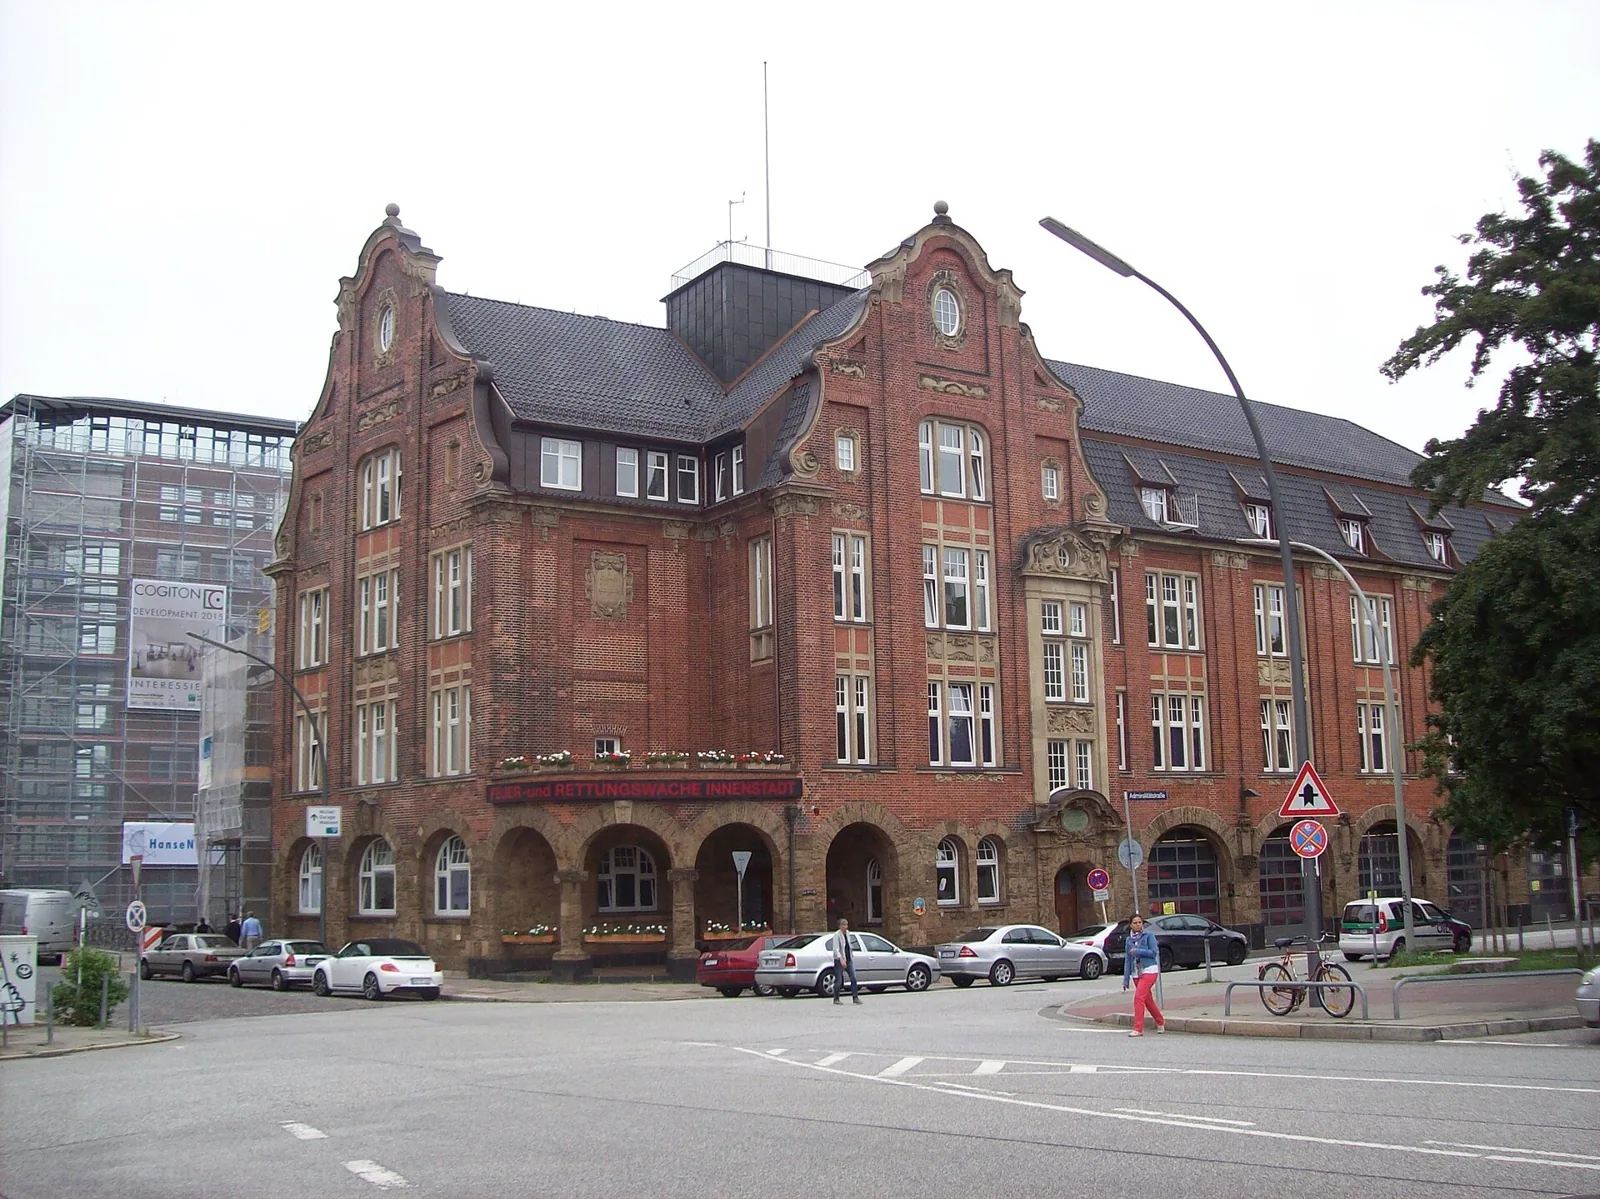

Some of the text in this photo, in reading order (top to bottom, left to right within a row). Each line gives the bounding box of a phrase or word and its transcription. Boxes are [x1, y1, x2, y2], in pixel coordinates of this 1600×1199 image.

[134, 584, 201, 599] COGITON
[133, 607, 224, 620] DEVELOPMENT 2015
[555, 783, 701, 797] RETTUNGSWACHE
[705, 781, 796, 795] INNENSTADT
